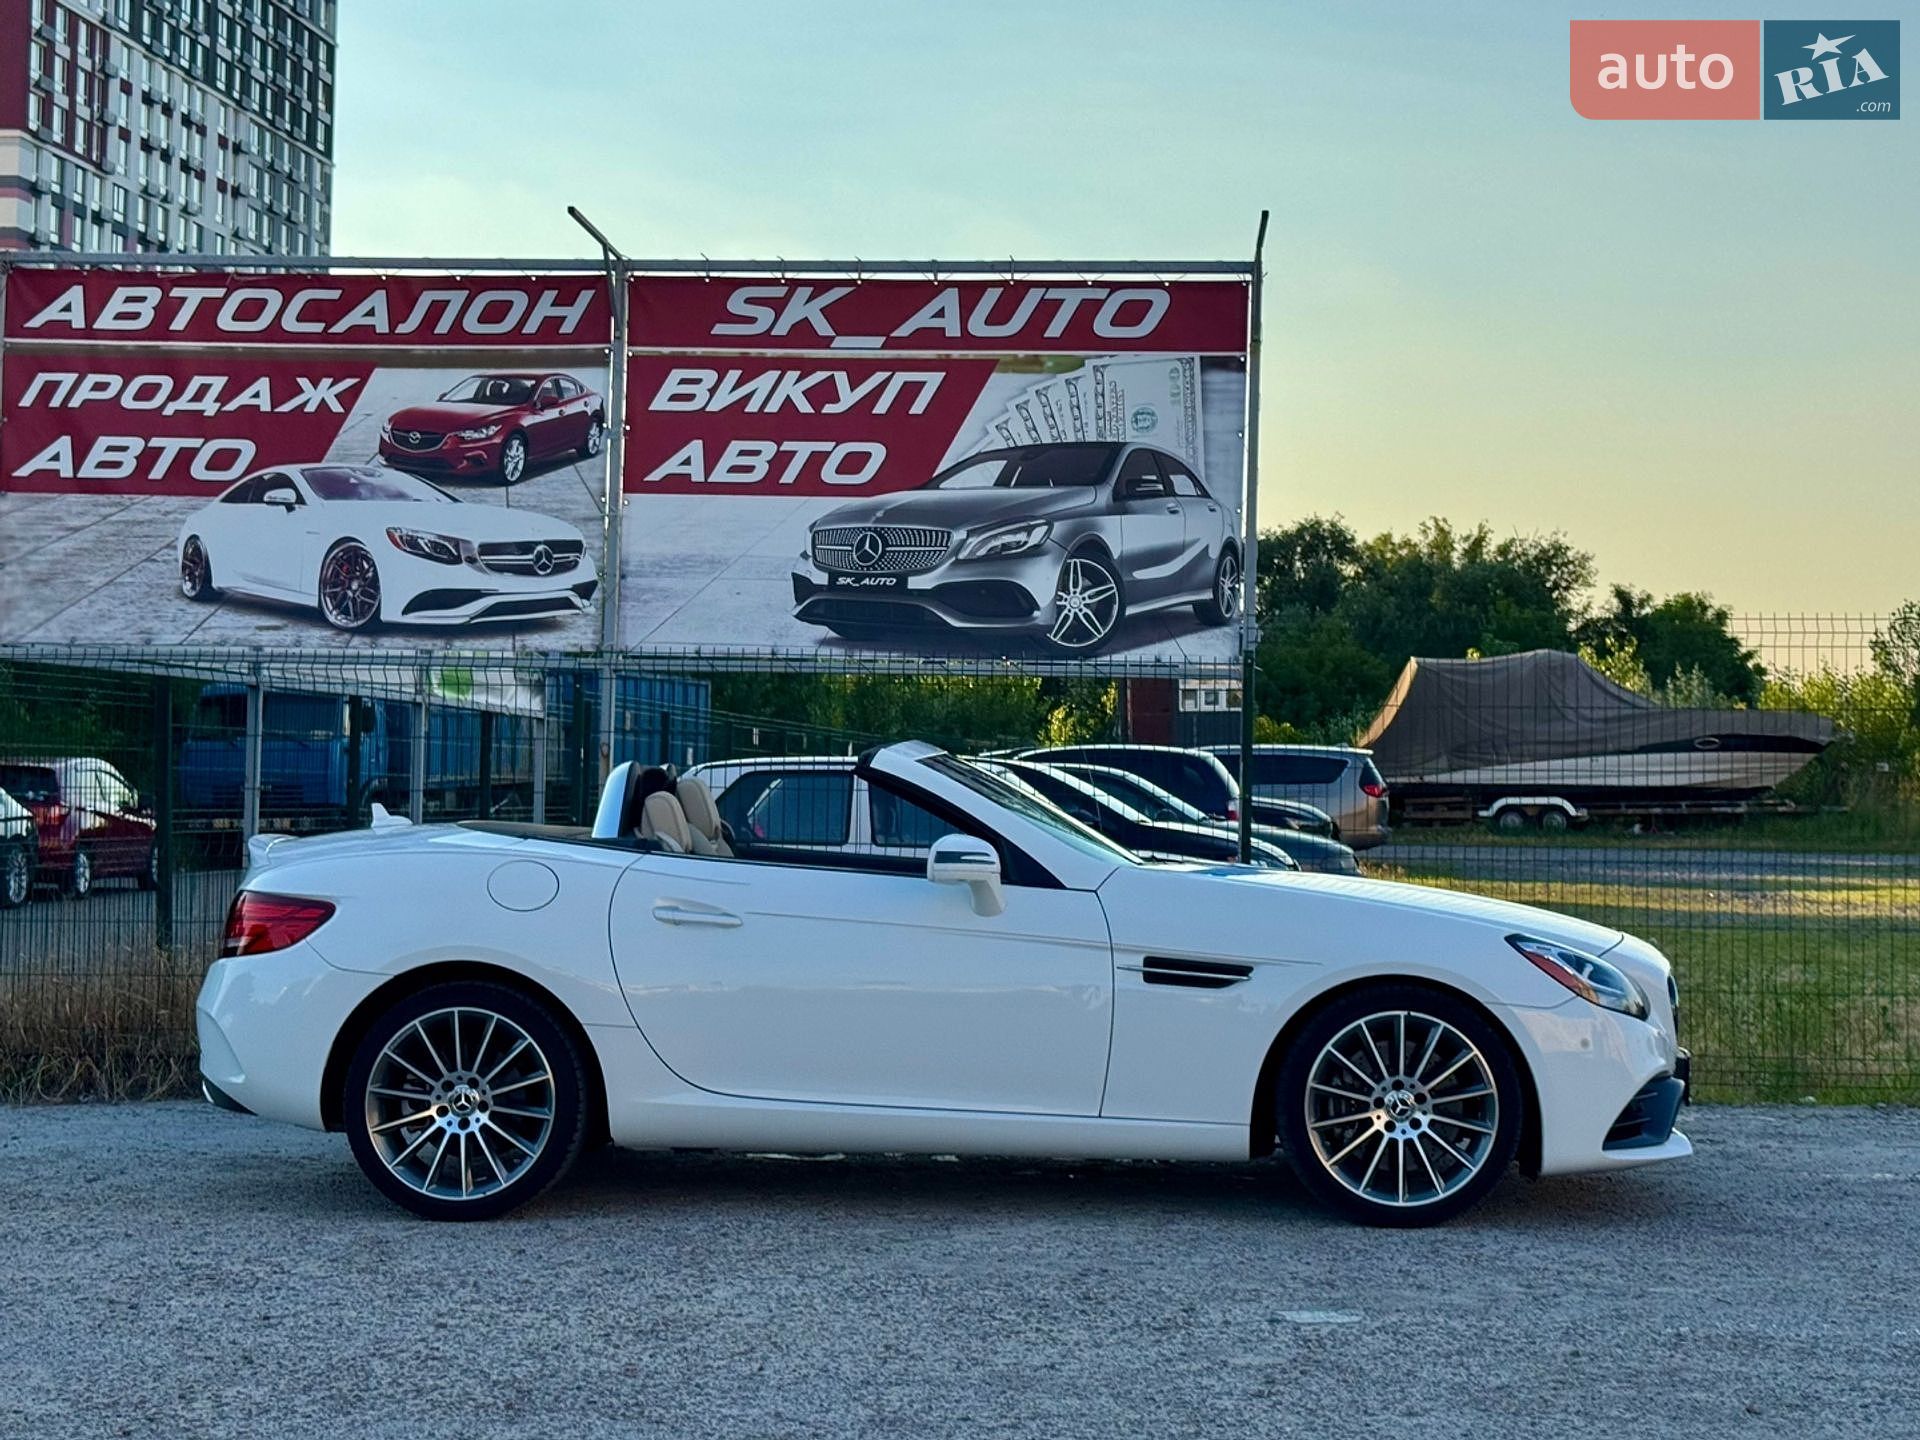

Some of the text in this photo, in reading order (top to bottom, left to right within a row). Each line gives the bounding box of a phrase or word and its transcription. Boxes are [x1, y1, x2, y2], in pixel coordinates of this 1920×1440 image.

[23, 284, 596, 335] АВТОСАЛОН
[710, 286, 1172, 348] SK_AUTO
[18, 372, 361, 417] ПРОДАЖ
[648, 368, 948, 415] ВИКУП
[11, 435, 258, 481] АВТО
[643, 439, 888, 485] АВТО
[836, 576, 897, 587] SK_AUTO
